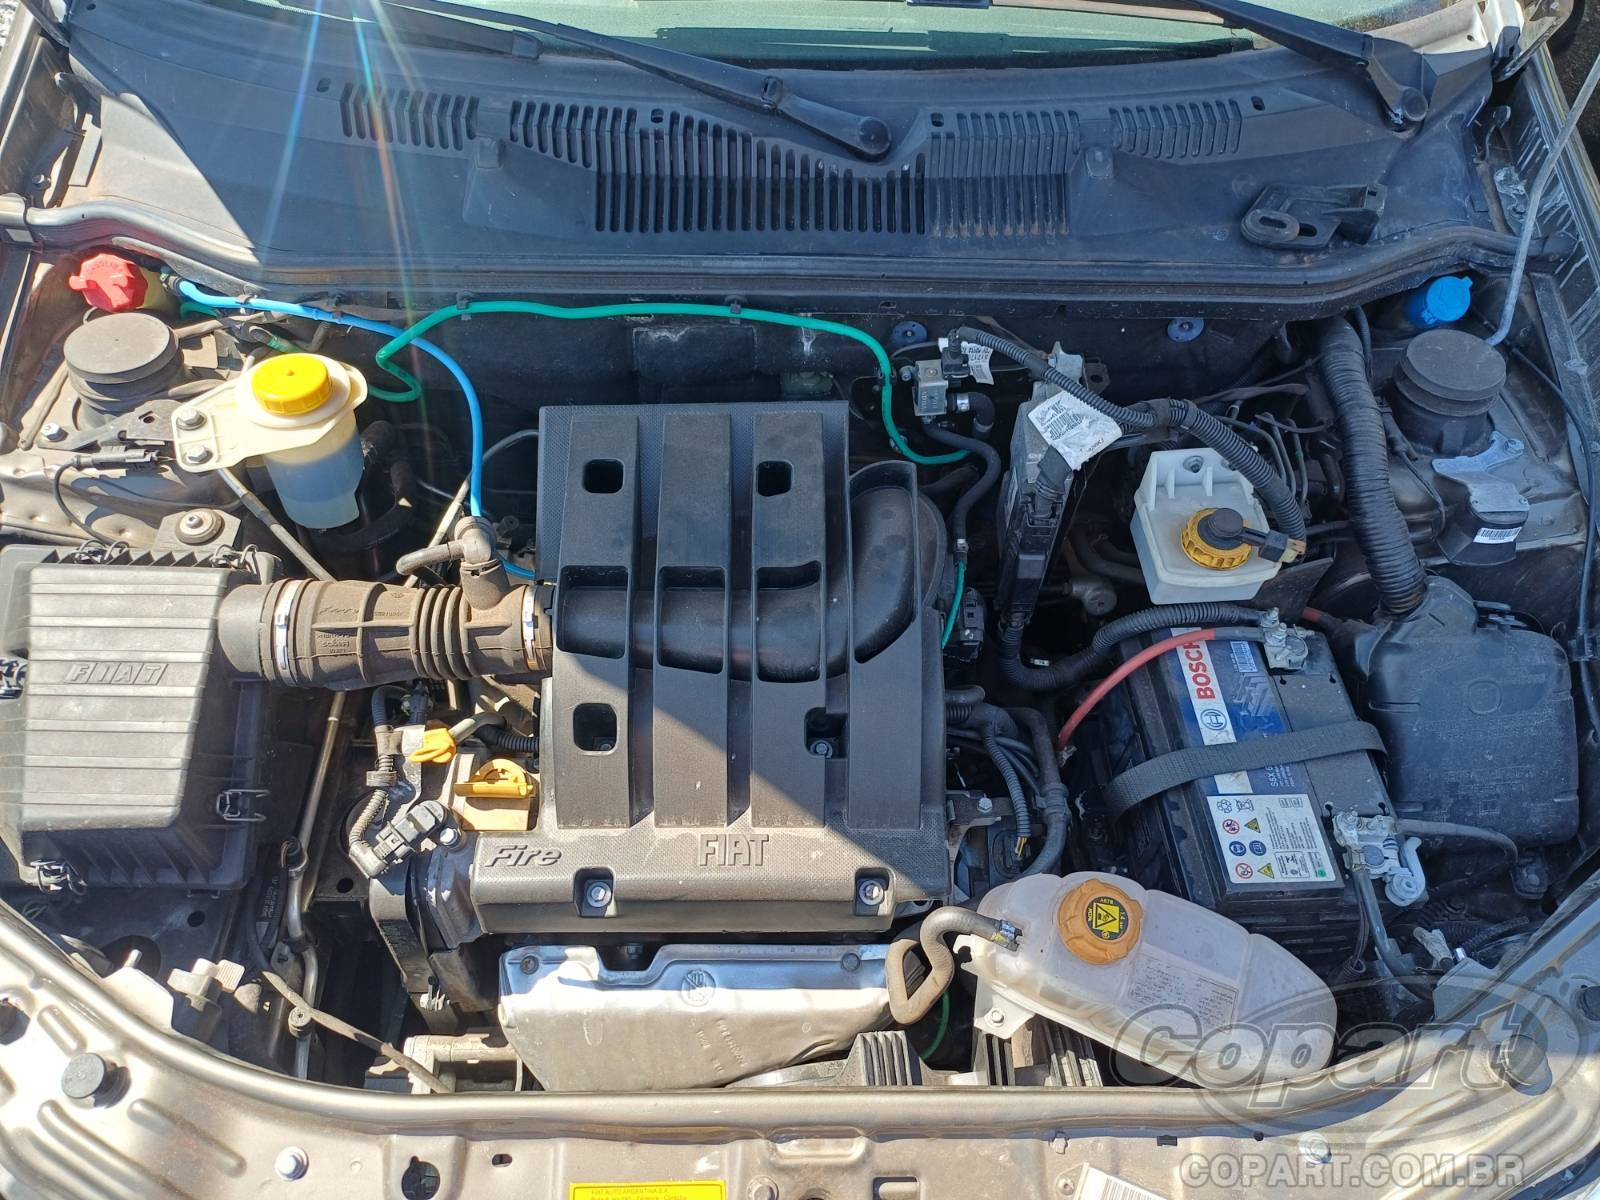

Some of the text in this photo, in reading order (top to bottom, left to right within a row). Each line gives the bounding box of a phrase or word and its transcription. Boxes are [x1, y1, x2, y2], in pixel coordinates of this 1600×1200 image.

[68, 662, 167, 685] FIAT
[483, 844, 562, 868] Fire
[699, 834, 769, 866] FIAT
